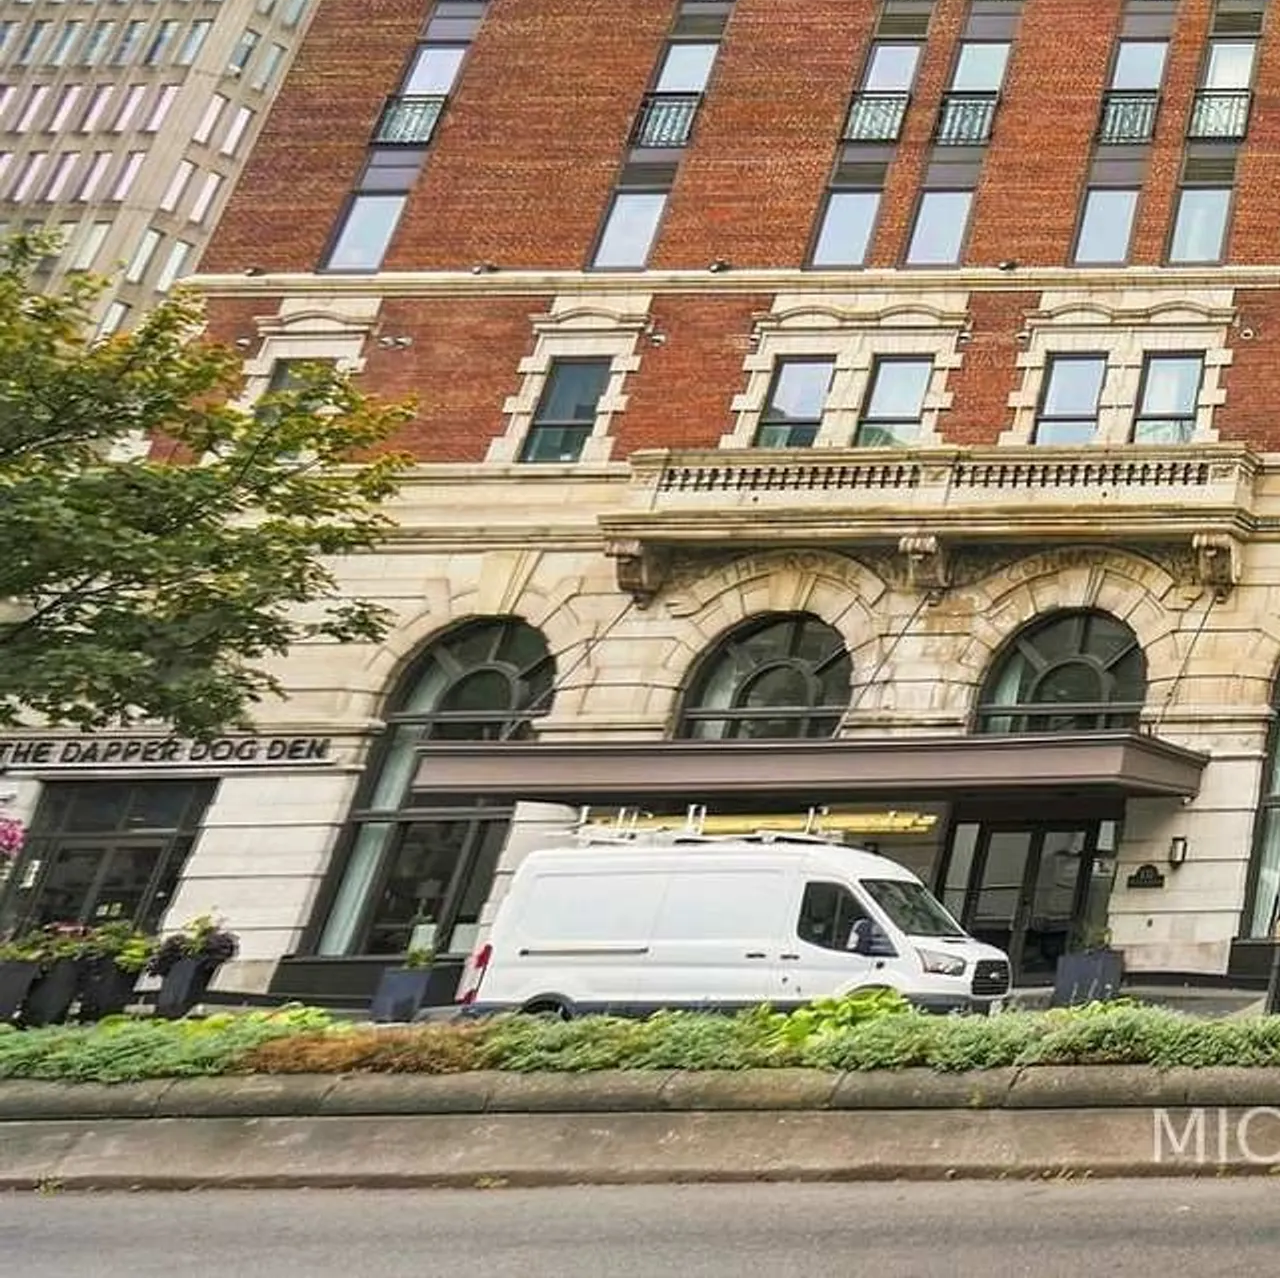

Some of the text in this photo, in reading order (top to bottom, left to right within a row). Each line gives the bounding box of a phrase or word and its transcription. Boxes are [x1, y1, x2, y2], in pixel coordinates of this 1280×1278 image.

[0, 738, 331, 763] THE DAPPER DOG DEN
